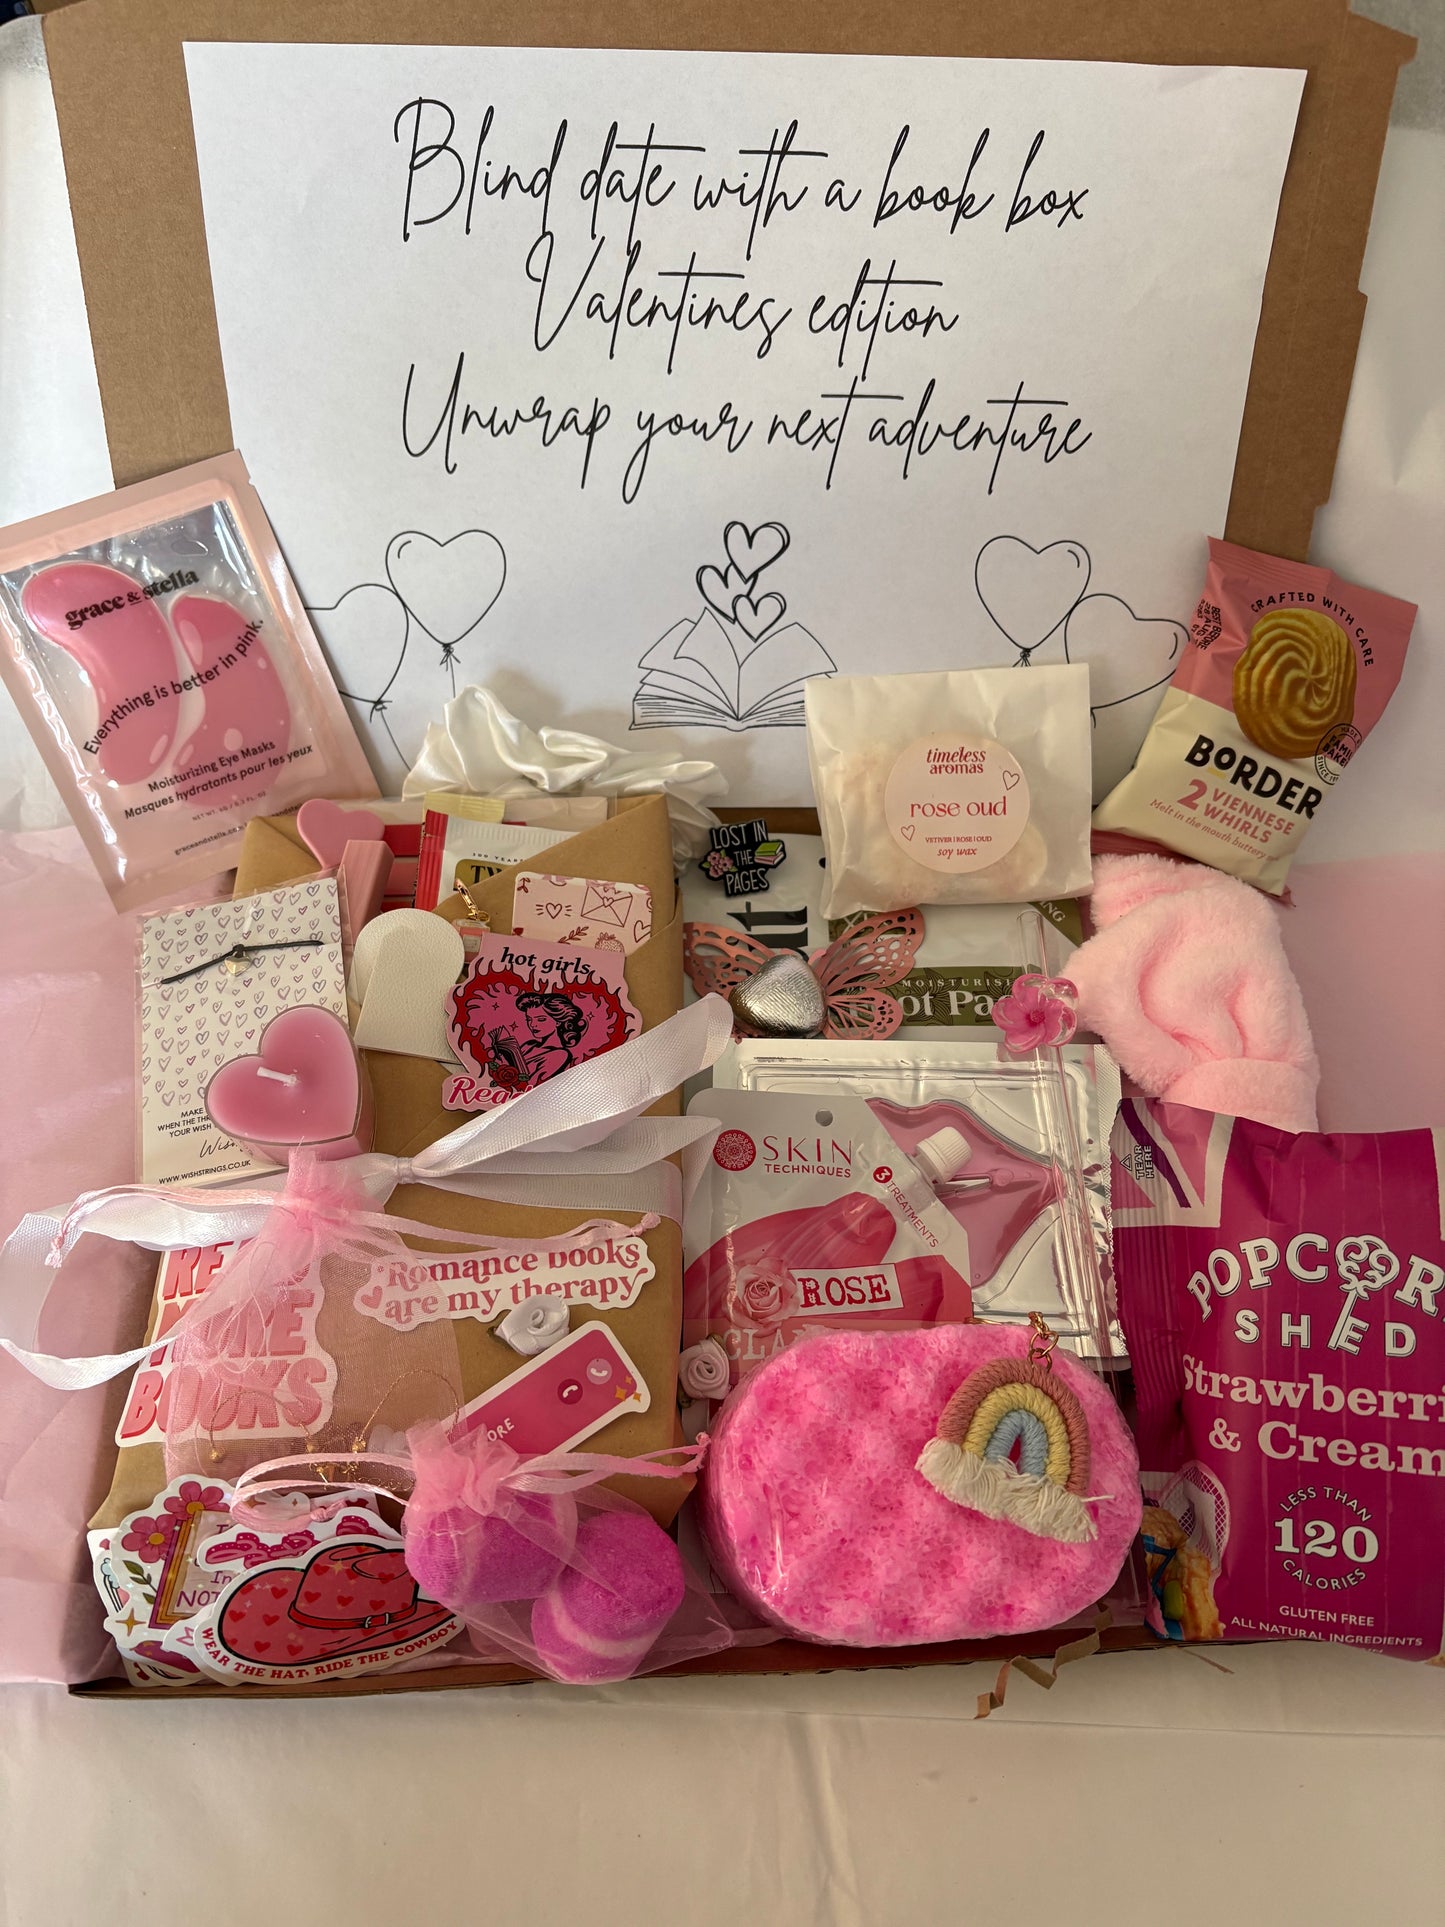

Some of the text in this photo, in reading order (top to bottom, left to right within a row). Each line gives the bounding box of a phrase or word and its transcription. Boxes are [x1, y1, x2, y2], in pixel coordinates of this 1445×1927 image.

[394, 96, 1089, 261] Blind date with a book box
[526, 231, 959, 382] Valentines edition
[402, 351, 1093, 504] Unwrap your next adventure
[64, 569, 200, 630] grace & stella
[1250, 591, 1374, 667] CRAFTED WITH CARE
[84, 619, 264, 755] Everything is better in pink.
[148, 740, 276, 793] Moisturizing Eye Masks
[926, 746, 987, 763] timeless
[929, 762, 984, 775] aromas
[1317, 756, 1329, 780] SINCE
[124, 744, 314, 820] Masques hydratants pour les yeux
[1184, 734, 1323, 820] BORDER
[910, 795, 1007, 818] rose oud
[1177, 778, 1295, 836] 2 VIENNESE
[1203, 803, 1272, 844] WHIRLS
[712, 820, 768, 849] LOST IN
[1149, 799, 1174, 815] Melt
[1173, 810, 1185, 822] in
[1184, 815, 1201, 829] the
[1200, 824, 1232, 845] mouth
[1231, 836, 1267, 860] buttery
[733, 849, 754, 866] THE
[937, 848, 978, 860] soy wax
[725, 867, 768, 895] PAGES
[501, 946, 591, 975] hot girls
[902, 978, 1012, 988] MOISTURISI
[157, 1114, 211, 1132] WHEN THE THR
[169, 1123, 212, 1138] YOUR WISH
[181, 1107, 204, 1118] MAKE
[762, 1135, 852, 1166] SKIN
[1133, 1144, 1146, 1180] TEAR
[1143, 1144, 1155, 1178] HERE
[158, 1159, 252, 1184] WWW.WISHSTRINGS.CO.UK
[764, 1163, 851, 1178] TECHNIQUES
[875, 1168, 939, 1248] 3 TREATMENTS
[386, 1237, 641, 1293] Romance books
[1187, 1232, 1445, 1323] POPCOR
[384, 1267, 649, 1325] are my therapy
[798, 1273, 892, 1309] ROSE
[1233, 1308, 1418, 1358] SHED
[121, 1356, 328, 1439] BOOKS
[1208, 1417, 1445, 1478] & Cream
[1280, 1486, 1373, 1522] LESS THAN
[1273, 1517, 1380, 1564] 120
[1282, 1558, 1367, 1591] CALORIES
[1230, 1616, 1424, 1647] ALL NATURAL INGREDIENTS
[1278, 1605, 1376, 1627] GLUTEN FREE
[201, 1627, 230, 1667] WEAR
[234, 1662, 266, 1677] THE
[314, 1660, 358, 1676] RIDE
[358, 1652, 390, 1665] THE
[393, 1621, 459, 1657] COWBOY
